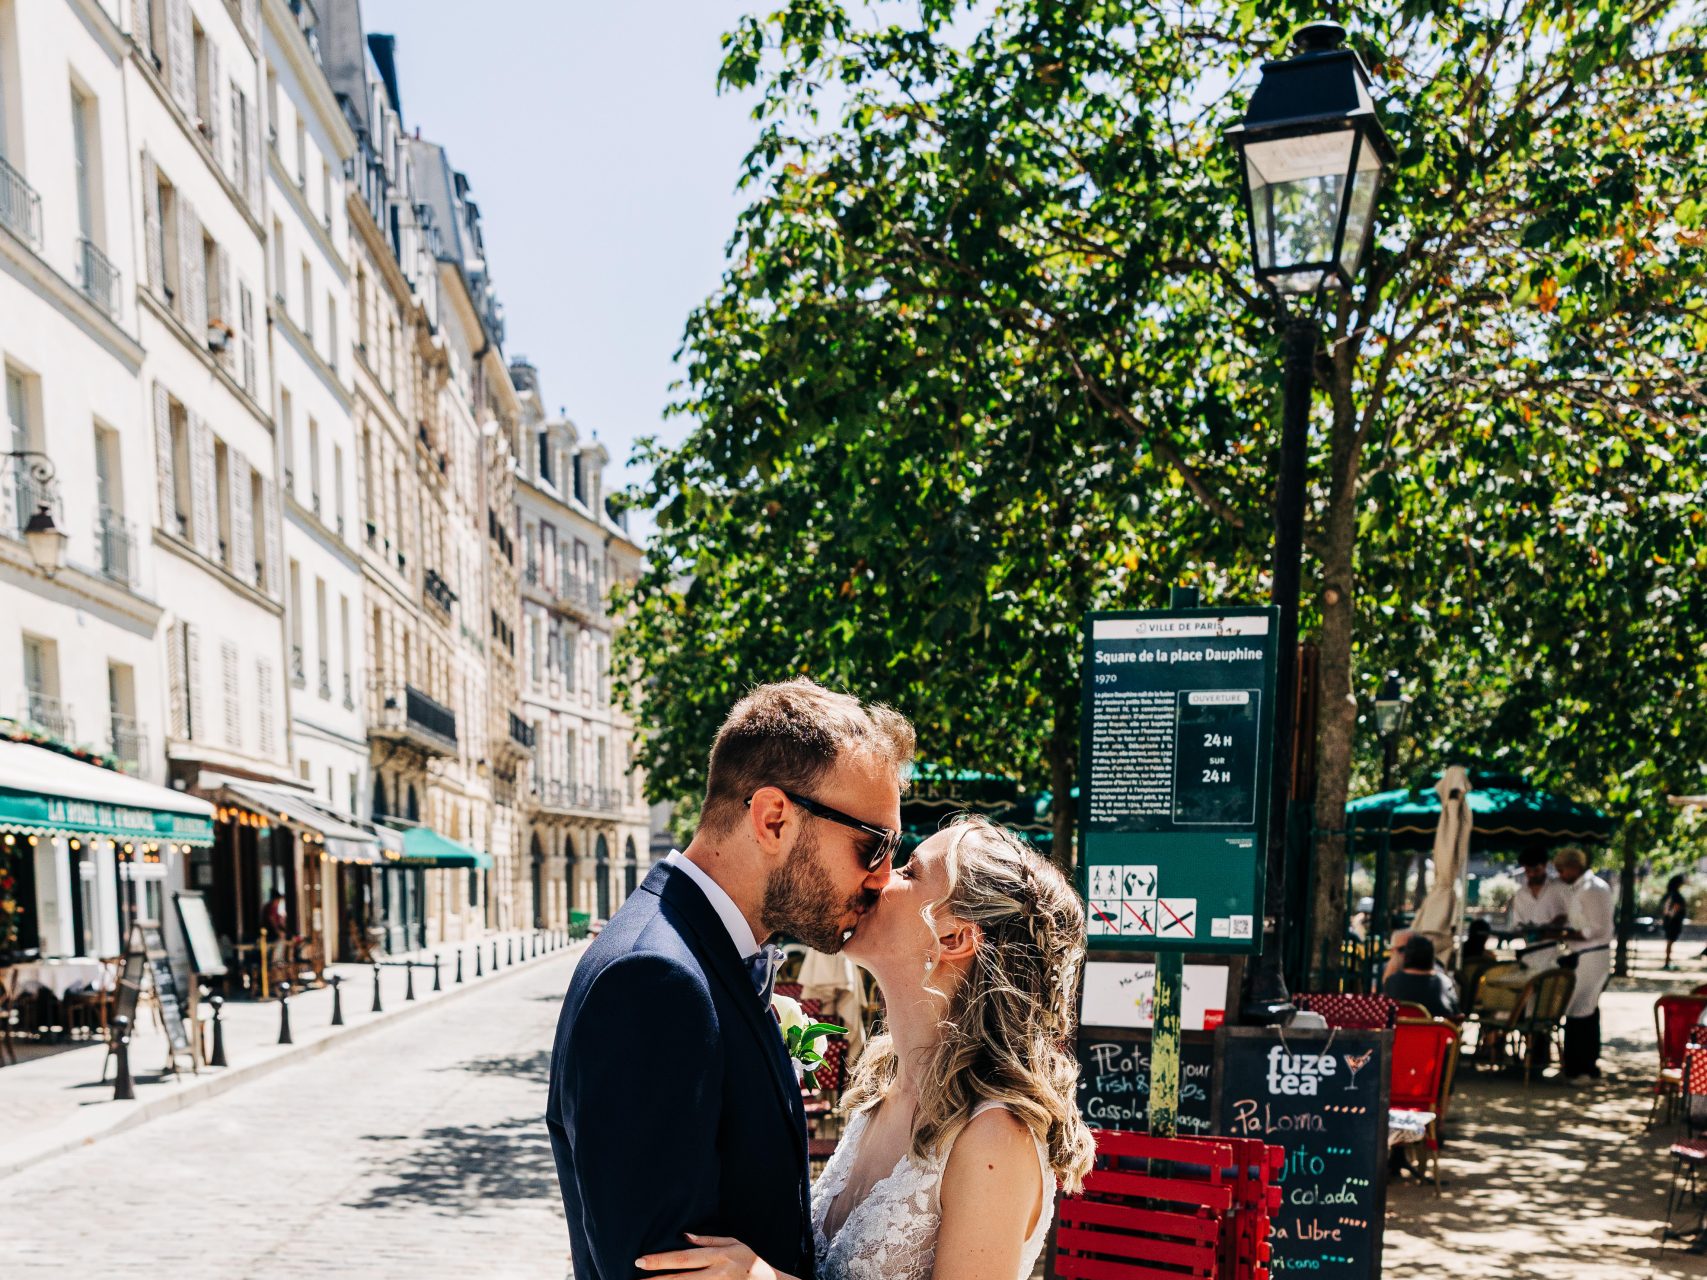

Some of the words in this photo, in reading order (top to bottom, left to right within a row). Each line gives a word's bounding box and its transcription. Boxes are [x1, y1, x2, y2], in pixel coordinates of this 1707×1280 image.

[1149, 624, 1175, 632] VILLE
[1179, 623, 1190, 631] DE
[1194, 621, 1222, 630] PARIS
[1095, 650, 1136, 666] Square
[1139, 649, 1153, 662] de
[1156, 649, 1168, 662] la
[1170, 649, 1202, 664] place
[1205, 647, 1263, 664] Dauphine
[1095, 674, 1117, 684] 1970
[1192, 694, 1241, 703] OUVERTURE
[1203, 734, 1221, 747] 24
[1223, 736, 1233, 747] H
[1209, 757, 1226, 765] SUR
[1202, 770, 1220, 783] 24
[1222, 771, 1231, 782] H
[1267, 1045, 1337, 1075] fuze
[1136, 1074, 1149, 1094] &
[1266, 1072, 1318, 1096] tea
